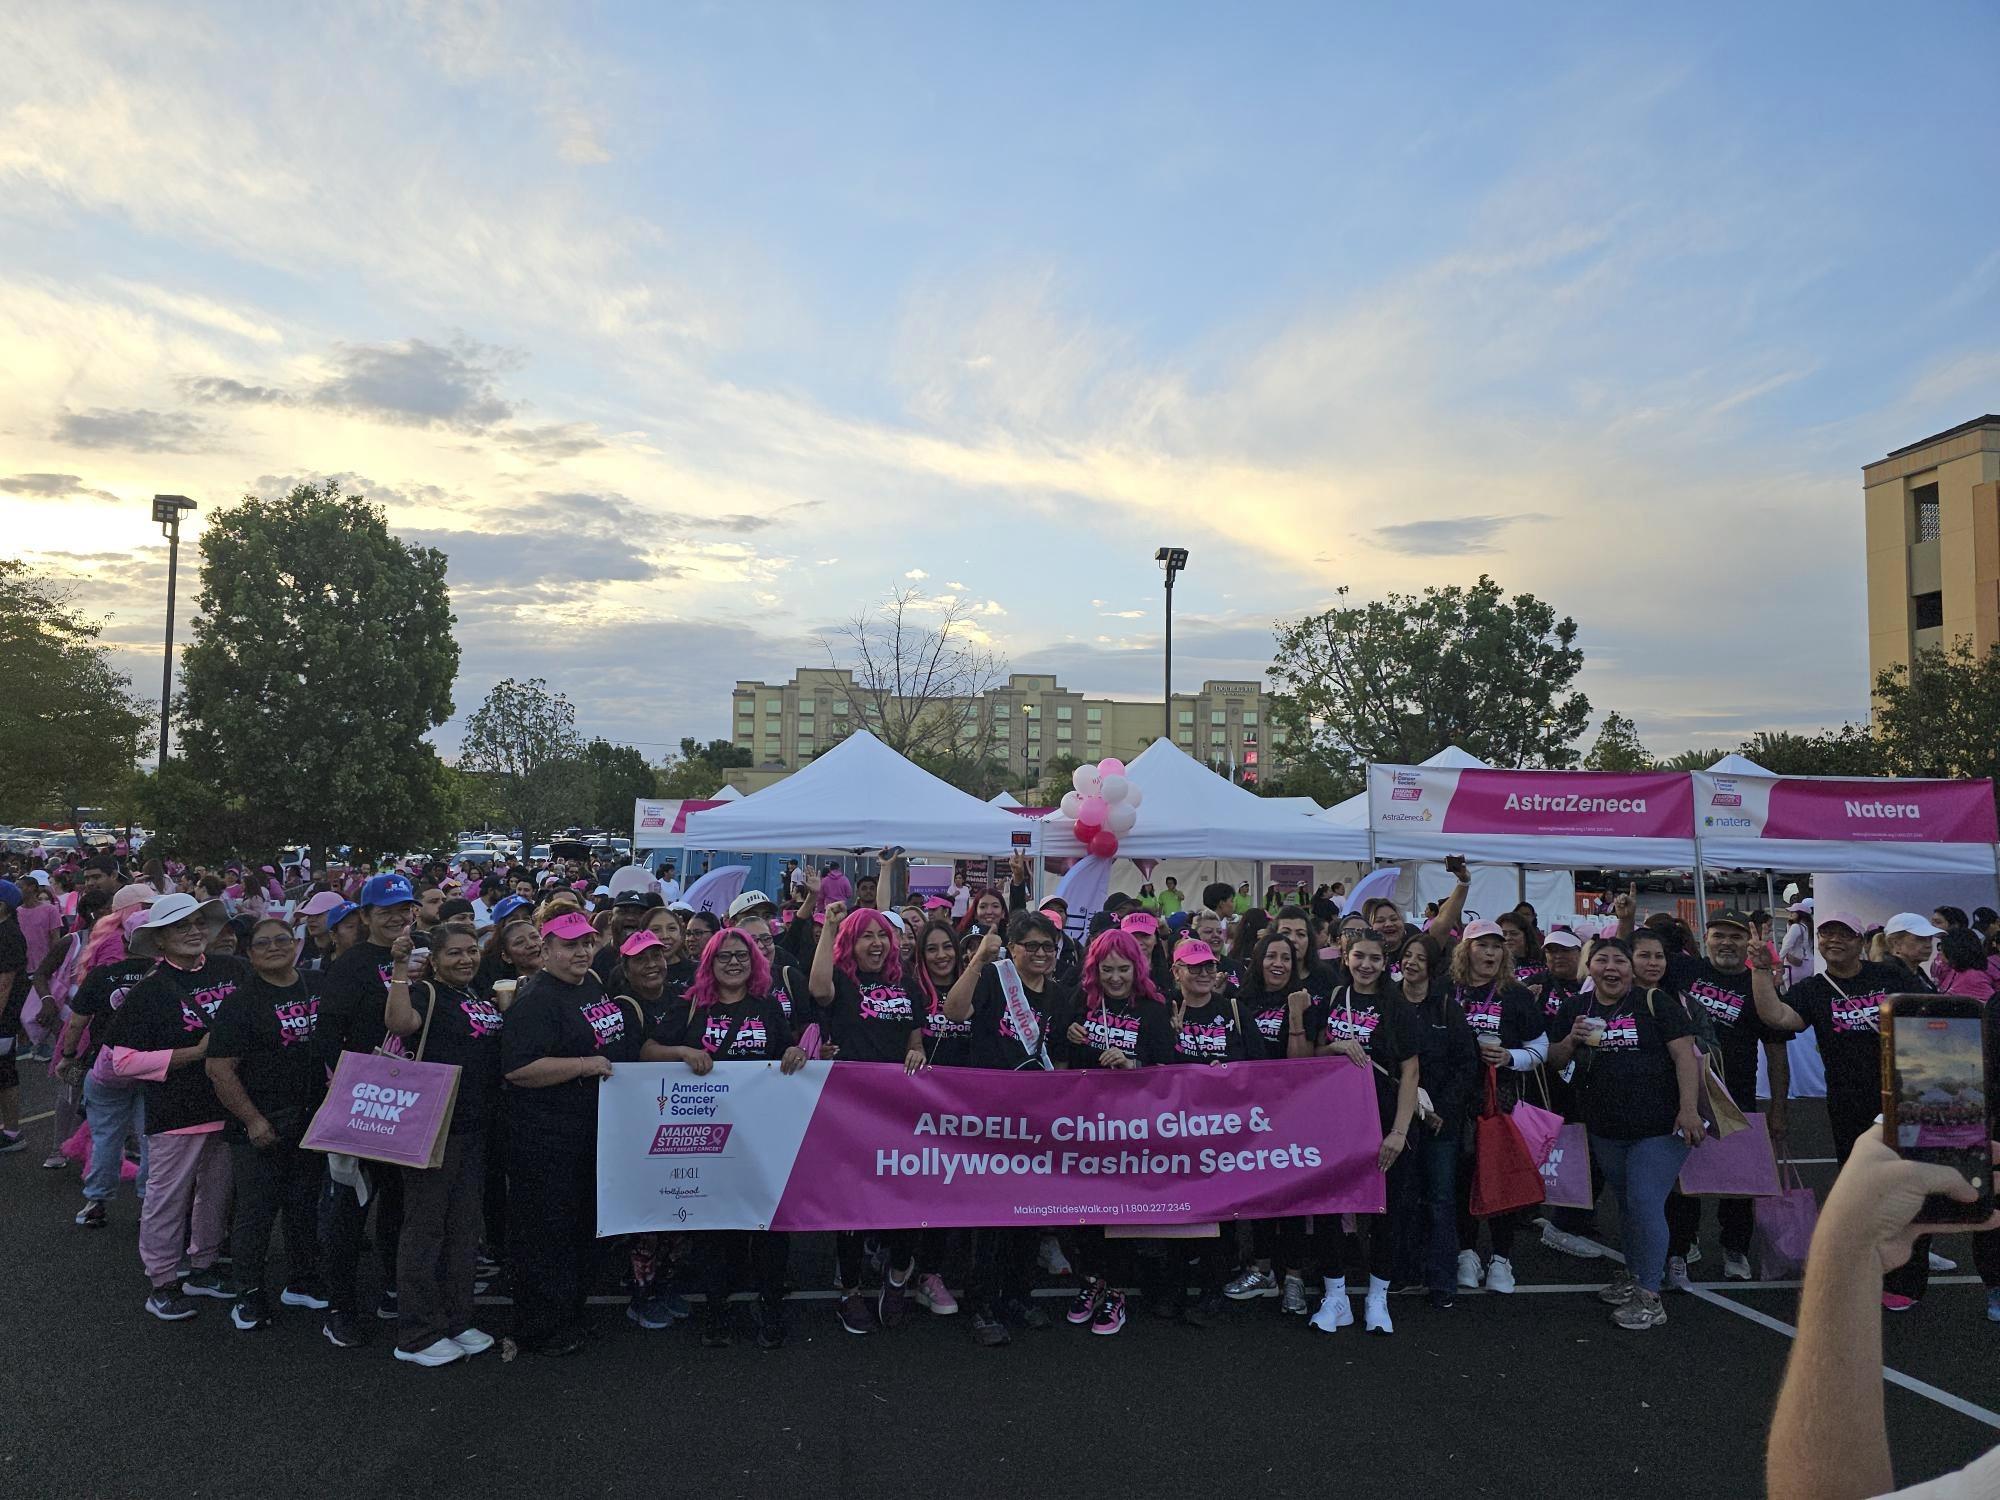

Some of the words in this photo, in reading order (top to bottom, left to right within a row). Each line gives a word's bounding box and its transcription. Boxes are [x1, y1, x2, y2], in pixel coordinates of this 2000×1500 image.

[1504, 793, 1646, 813] AstraZeneca
[1845, 800, 1920, 818] Natera
[1382, 813, 1424, 822] AstraZeneca
[1716, 817, 1751, 827] natera
[1690, 982, 1745, 1008] LOVE
[276, 1000, 320, 1020] LOV
[583, 1002, 621, 1022] LOVE
[1008, 985, 1034, 1040] Survivor
[1833, 1006, 1880, 1019] HOP
[930, 1023, 971, 1032] SUPPOR
[1087, 1010, 1140, 1031] LOVE
[1084, 1021, 1138, 1042] HOPE
[715, 1039, 767, 1048] SPPORT
[352, 1083, 420, 1108] GROW
[671, 1083, 729, 1093] American
[671, 1094, 715, 1104] Cancer
[351, 1100, 404, 1122] PINK
[671, 1105, 716, 1117] Society
[347, 1118, 396, 1135] AltaMed
[660, 1127, 711, 1137] MAKING
[913, 1113, 1043, 1144] ARDELL,
[1051, 1113, 1149, 1142] China
[1156, 1111, 1242, 1138] Glaze
[1250, 1106, 1273, 1132] &
[657, 1137, 707, 1147] STRIDES
[876, 1147, 1053, 1184] Hollywood
[1061, 1149, 1191, 1174] Fashion
[1199, 1143, 1322, 1173] Secrets
[659, 1186, 699, 1199] Hollywood
[1014, 1204, 1119, 1216] MakingStridesWalk.org
[1125, 1203, 1191, 1213] 1.800.227.2345
